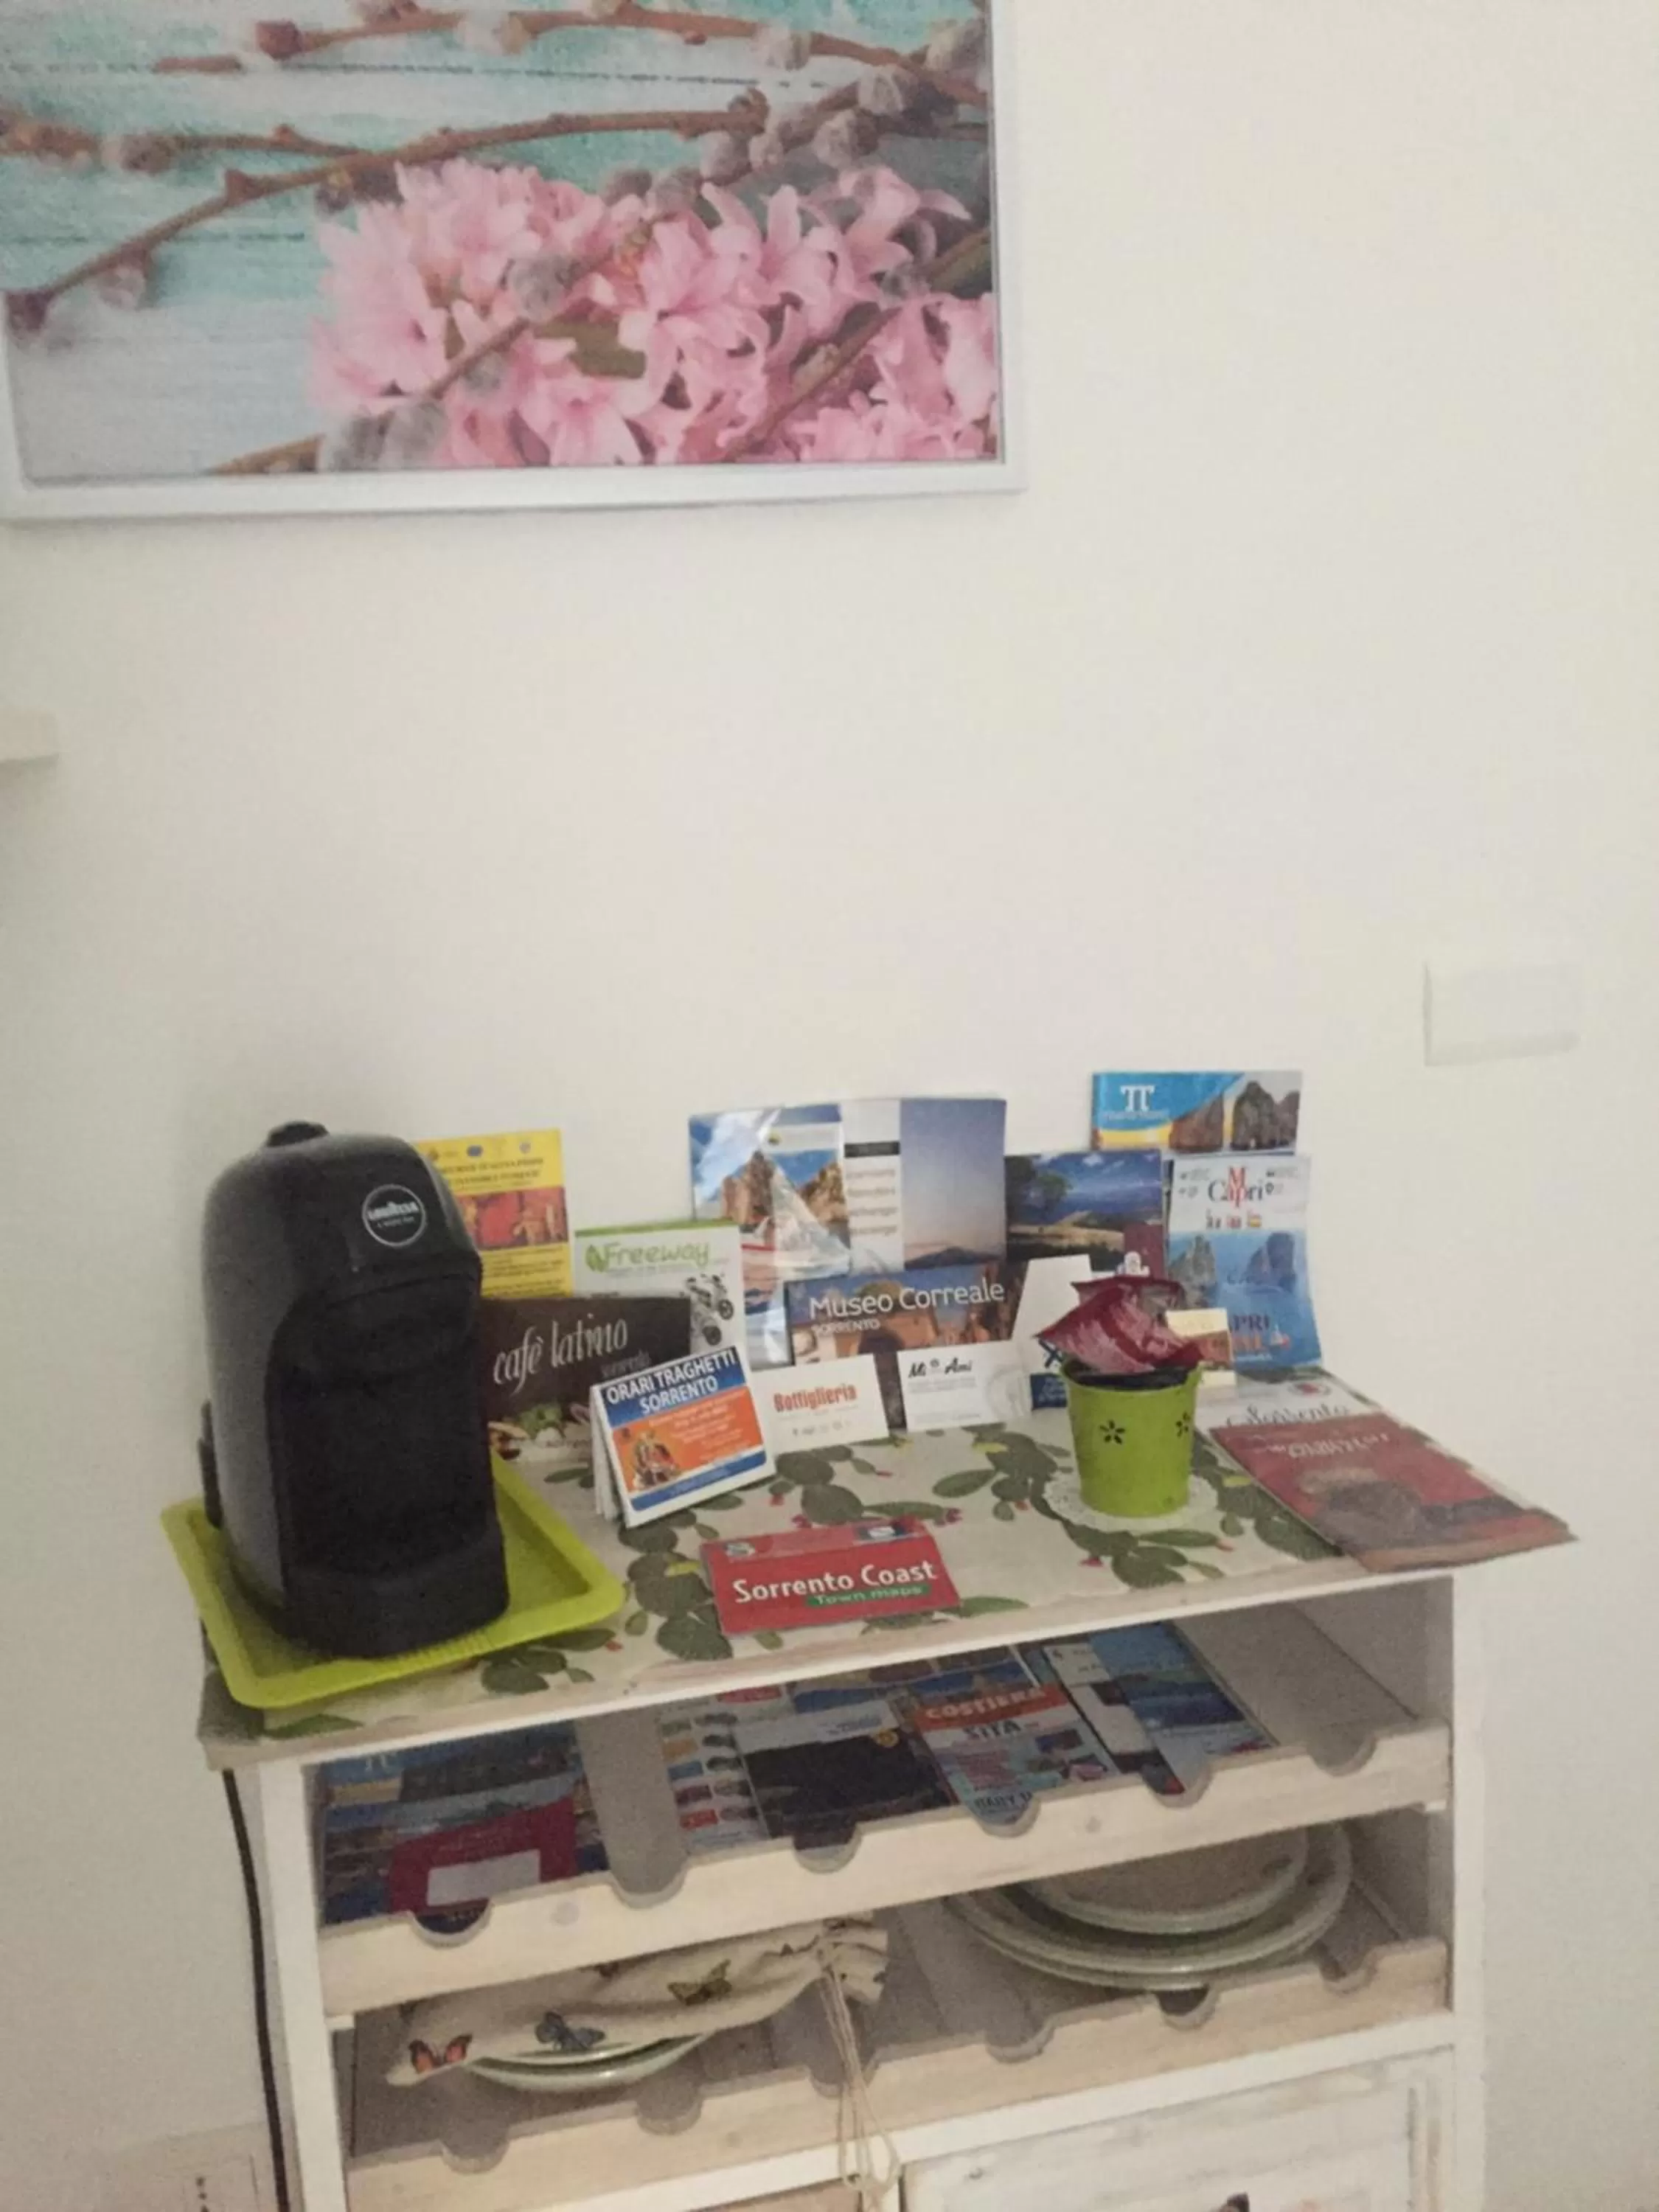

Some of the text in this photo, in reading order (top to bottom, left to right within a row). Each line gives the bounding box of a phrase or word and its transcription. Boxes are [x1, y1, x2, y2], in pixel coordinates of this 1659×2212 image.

[605, 1241, 711, 1267] Freeway
[810, 1276, 1005, 1319] Museo Correale
[551, 1312, 628, 1368] latino
[605, 1349, 737, 1405] ORARI TRAGHETTI
[639, 1375, 720, 1415] SORRENTO
[731, 1559, 939, 1604] Sorrento Coast
[815, 1585, 922, 1606] Town maps
